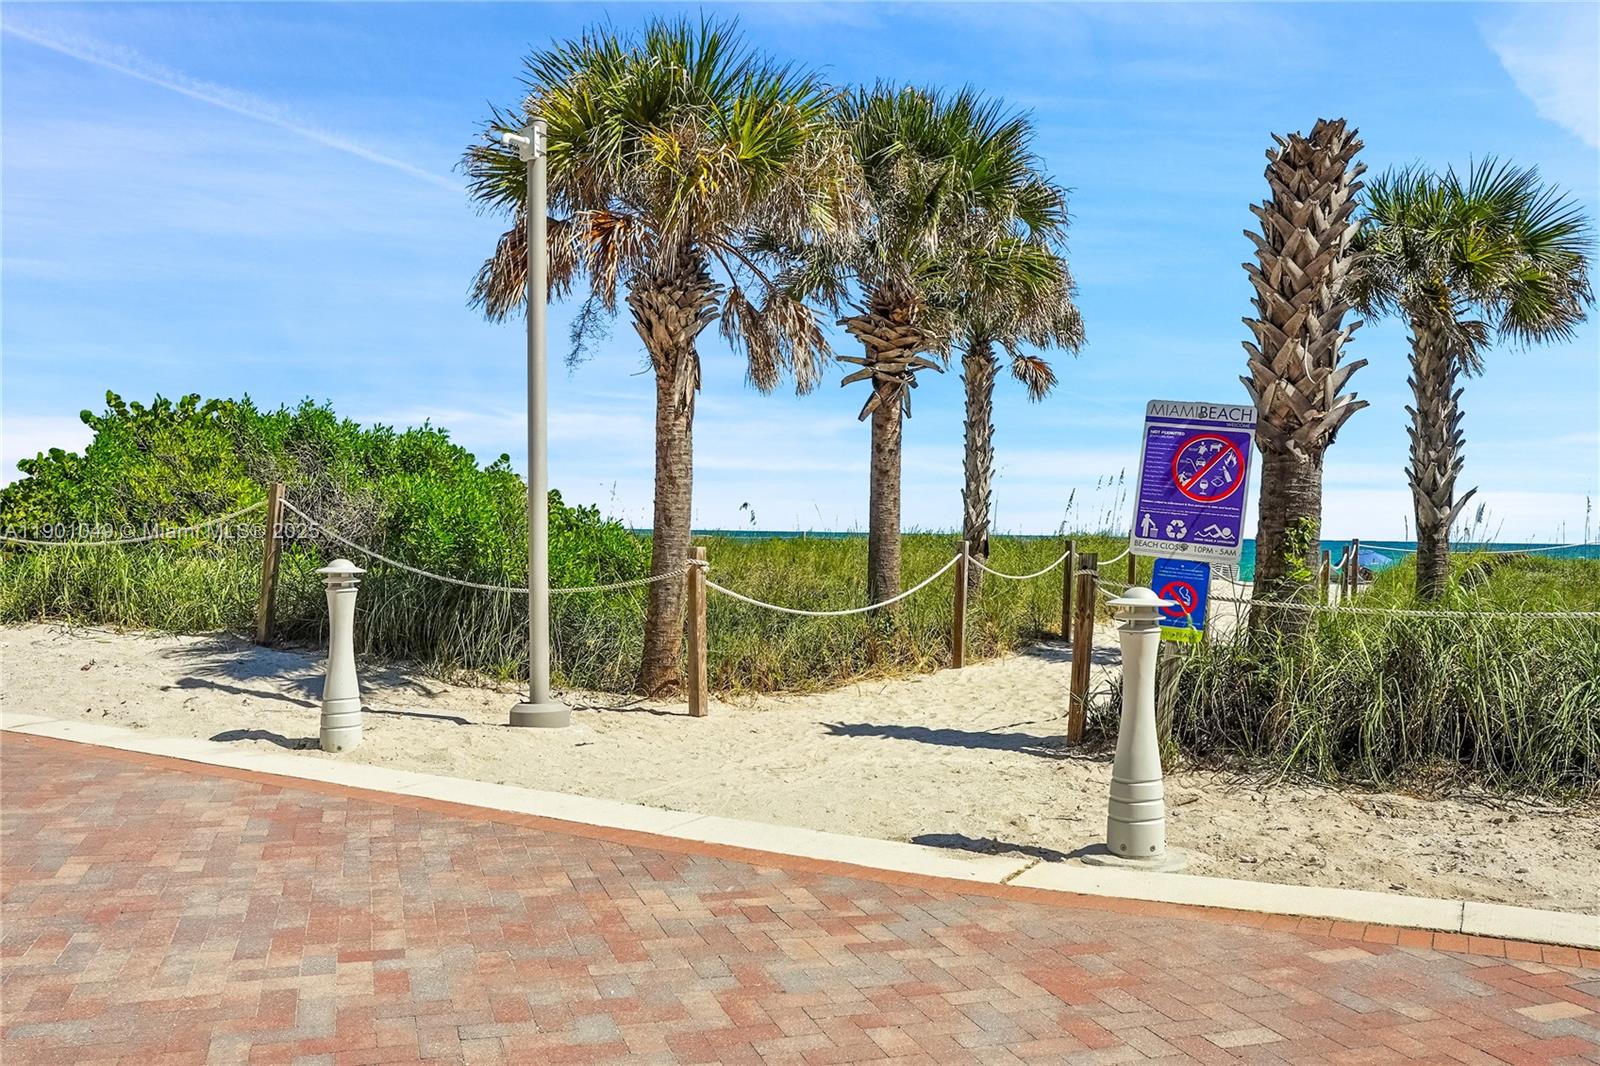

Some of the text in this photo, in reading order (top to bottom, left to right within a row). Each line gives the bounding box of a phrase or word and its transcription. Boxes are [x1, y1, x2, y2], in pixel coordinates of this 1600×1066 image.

[1134, 539, 1159, 548] BEACH
[1160, 542, 1189, 551] CLOS
[1193, 545, 1214, 554] 10PM
[1219, 548, 1237, 556] 5AM
